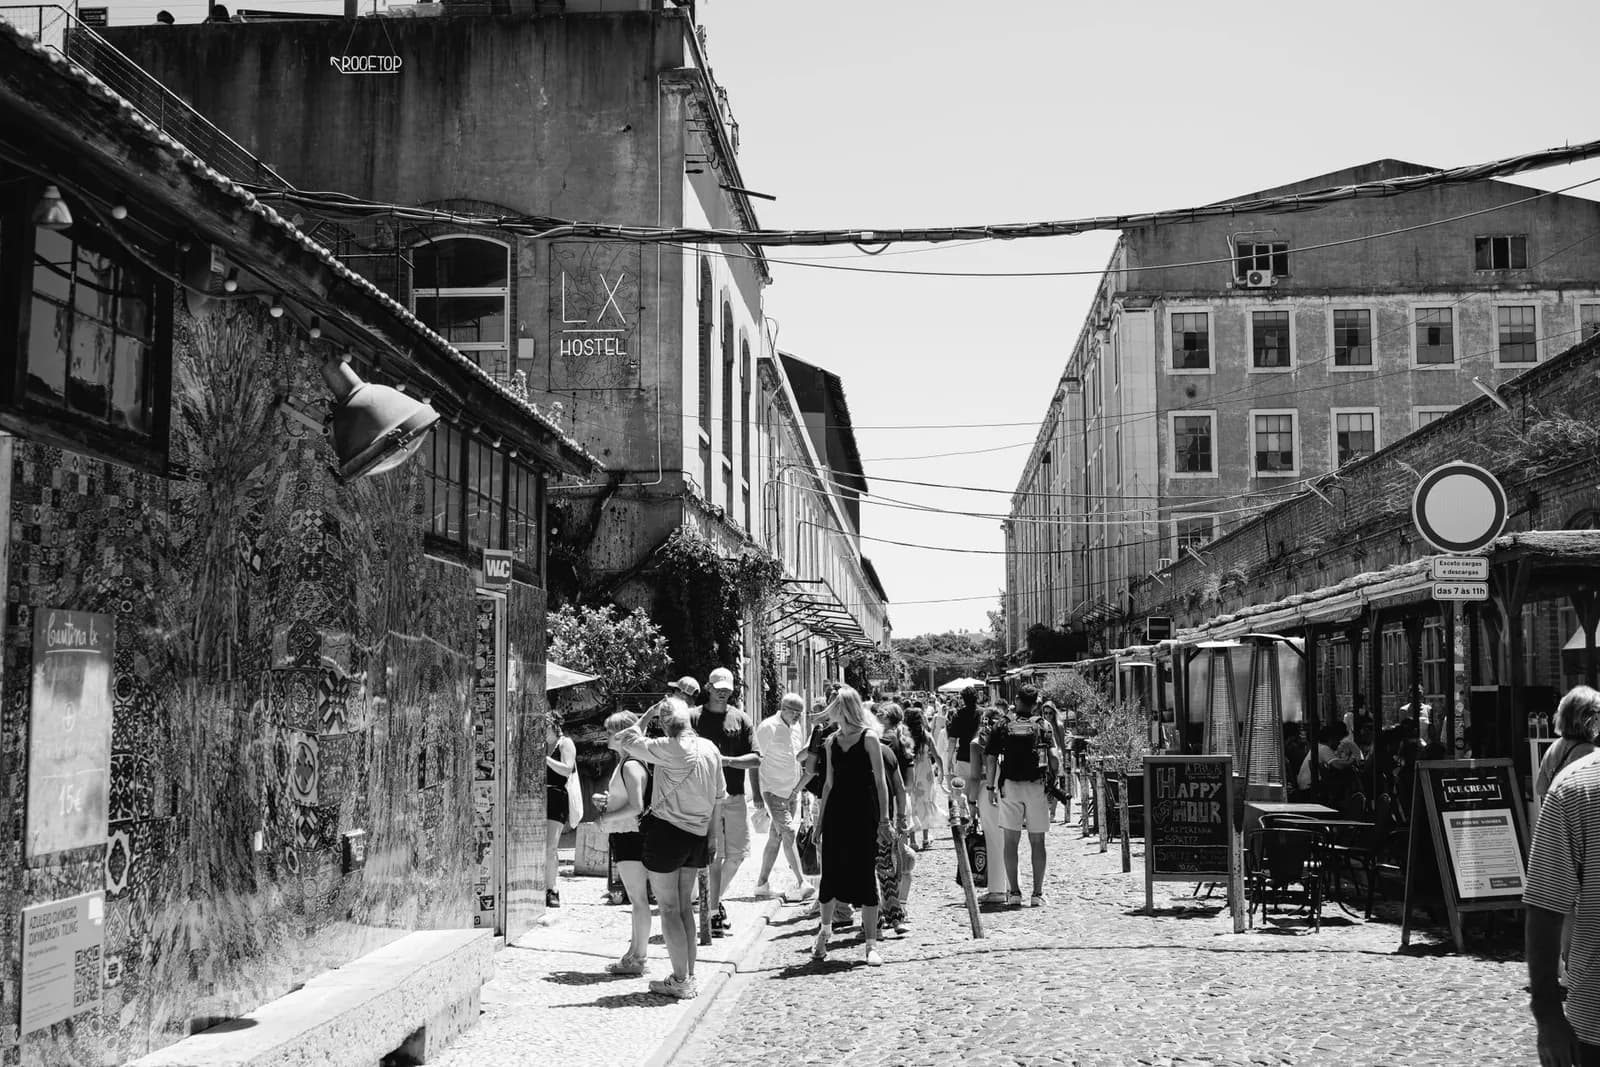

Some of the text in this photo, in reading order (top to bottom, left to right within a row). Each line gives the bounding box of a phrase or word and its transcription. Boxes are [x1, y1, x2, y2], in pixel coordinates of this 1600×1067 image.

[341, 55, 403, 71] ROOFTOP
[562, 271, 627, 324] LX
[560, 338, 627, 356] HOSTEL
[486, 559, 511, 578] WC
[1447, 784, 1496, 793] ICE CREAM
